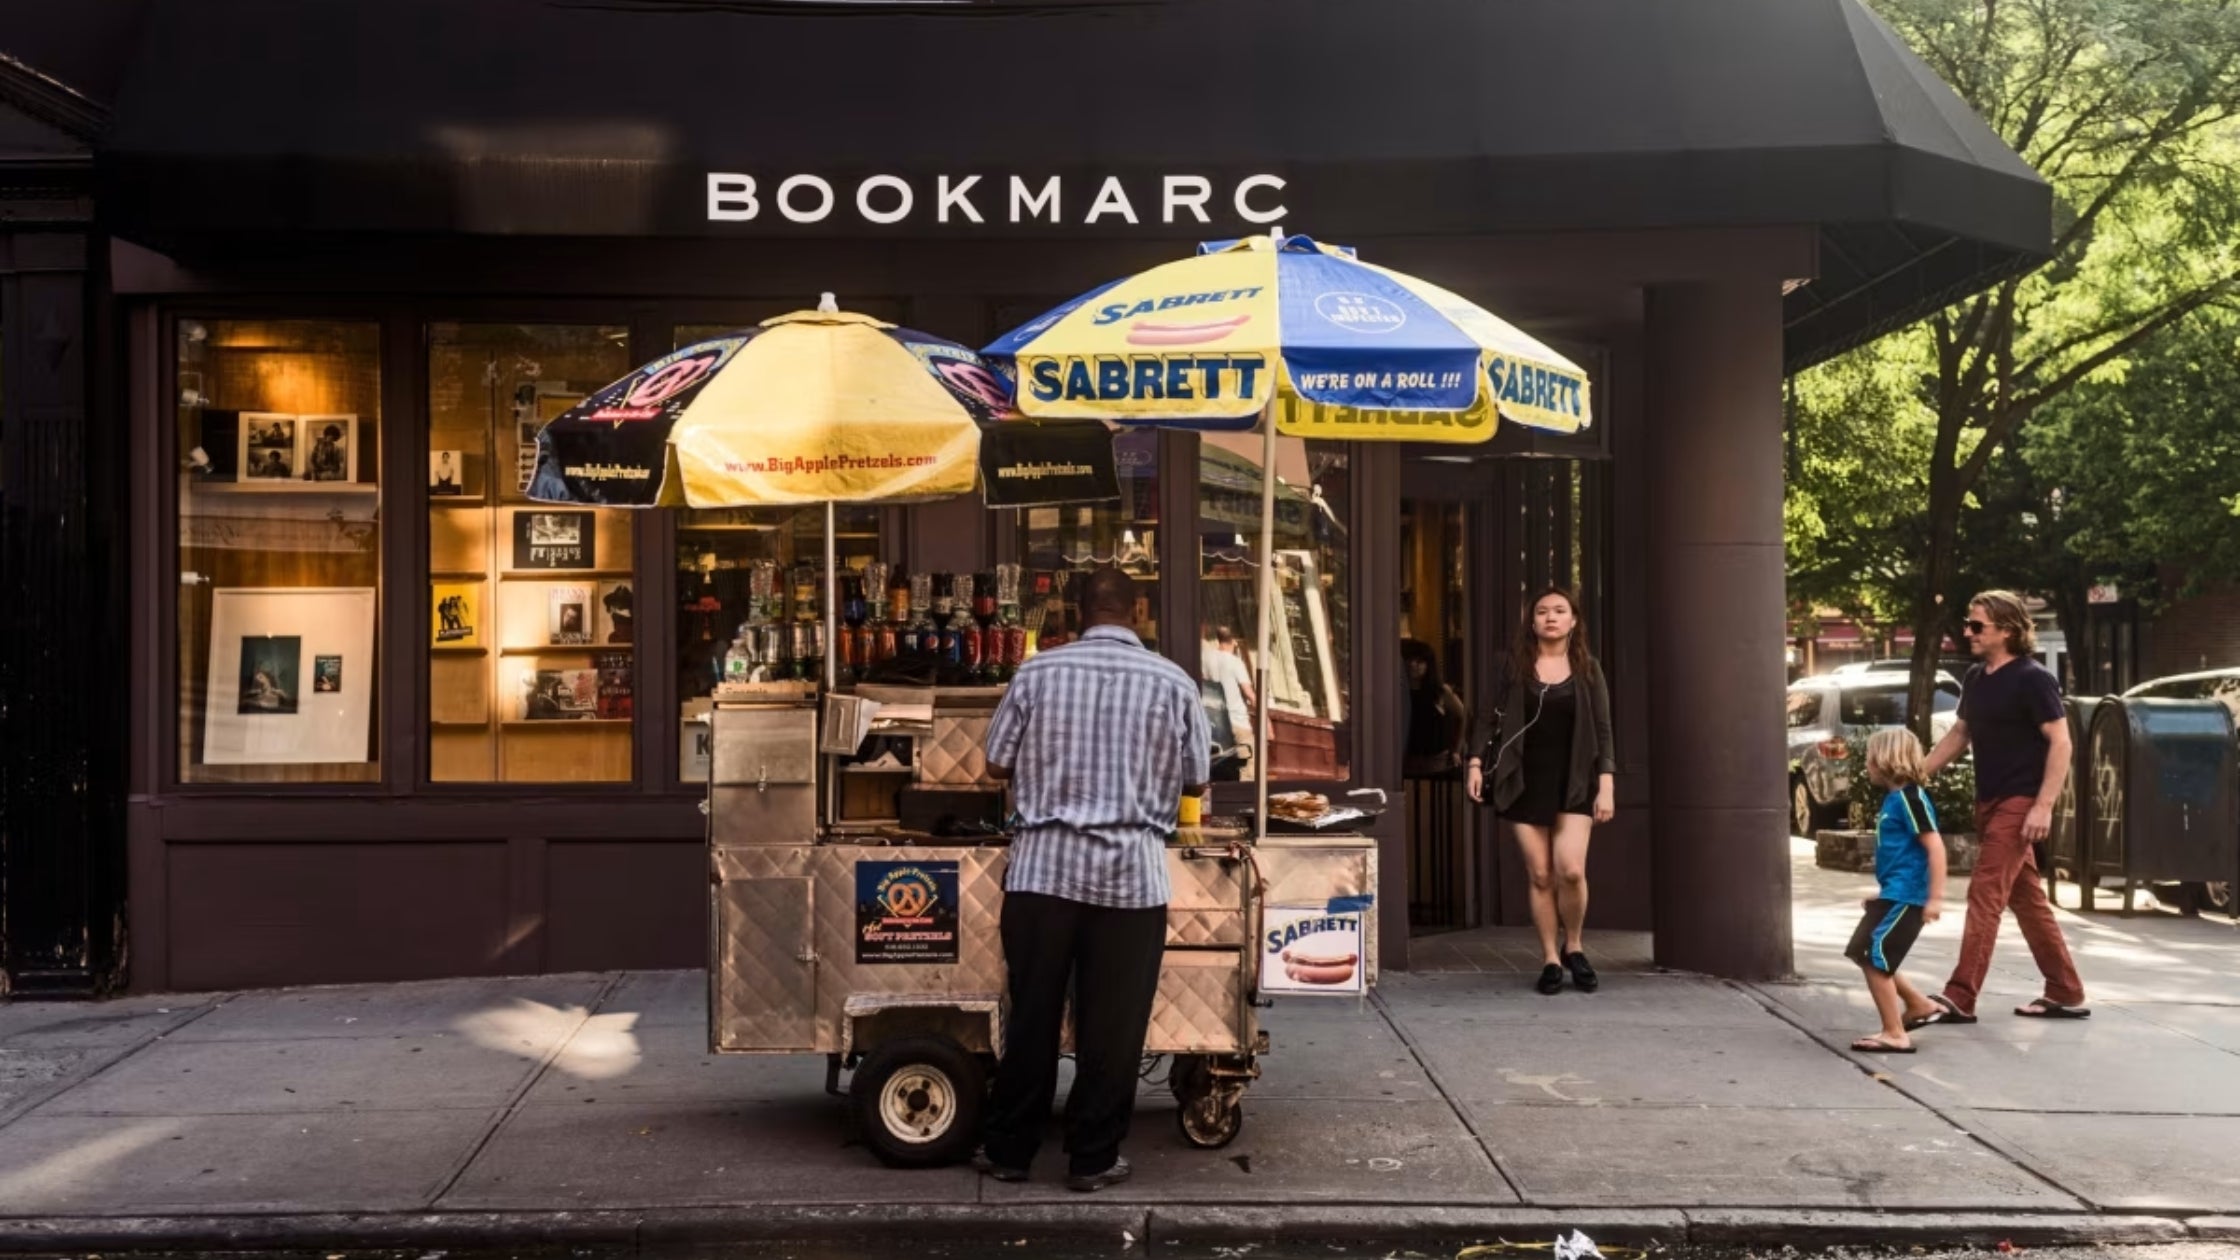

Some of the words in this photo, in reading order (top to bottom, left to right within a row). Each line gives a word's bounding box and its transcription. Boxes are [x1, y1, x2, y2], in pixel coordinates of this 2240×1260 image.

[706, 172, 1289, 224] BOOKMARC
[1092, 286, 1264, 326] SABRETT
[1030, 353, 1265, 402] SABRETT
[1300, 373, 1349, 390] WE'RE
[1354, 372, 1377, 389] ON
[1381, 373, 1392, 389] A
[1397, 372, 1437, 389] ROLL
[1440, 372, 1462, 389] !!!
[1488, 357, 1581, 417] SABRETT
[725, 453, 937, 475] www.BigApplePretzels.com
[1266, 915, 1358, 954] SABRETT
